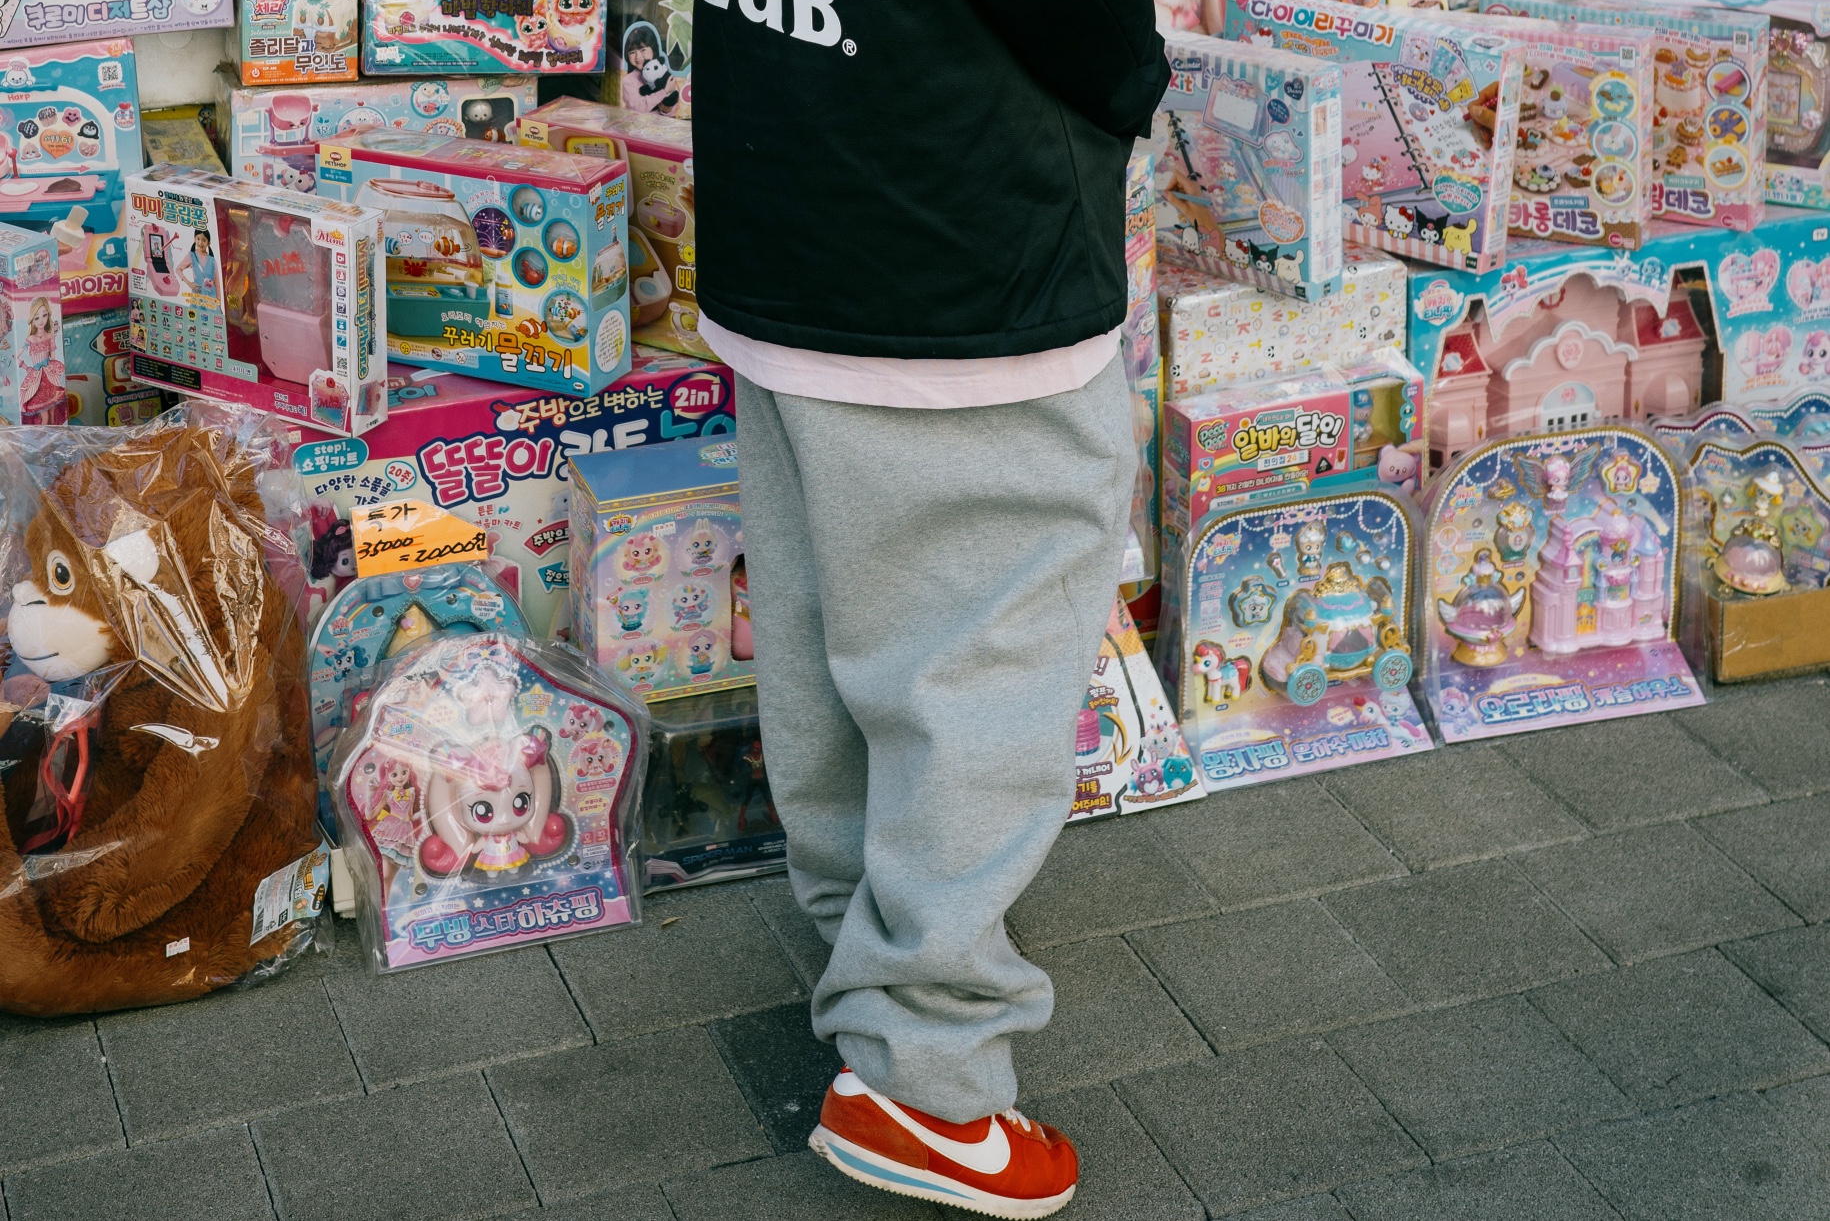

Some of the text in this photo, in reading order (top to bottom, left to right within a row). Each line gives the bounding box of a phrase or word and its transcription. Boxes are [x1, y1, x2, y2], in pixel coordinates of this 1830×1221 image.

[26, 0, 85, 32] 쿠로미
[1249, 0, 1395, 46] 다이어리꾸미기
[294, 53, 348, 75] 무인도
[1169, 72, 1193, 94] Kit
[7, 92, 31, 103] Harp
[325, 160, 348, 168] PETSHOP
[132, 193, 163, 220] 미미
[162, 199, 209, 230] 플립폰
[1664, 188, 1713, 215] 데코
[1552, 210, 1601, 236] 데코
[1814, 229, 1826, 240] TV
[315, 229, 346, 247] Mimi
[260, 258, 308, 278] Mimi
[442, 325, 573, 379] 꾸러기 물꼬기
[673, 385, 721, 408] 2in1
[514, 385, 665, 434] 주방으로 변하는
[1233, 412, 1346, 462] 알바의 달인
[314, 443, 352, 457] step1.
[301, 455, 359, 472] 쇼핑카트
[424, 437, 552, 505] 똘똘이
[314, 475, 392, 497] 다양한 소품을
[368, 502, 417, 533] 특가
[477, 503, 495, 516] 튼튼
[503, 519, 522, 531] 카트
[357, 536, 414, 561] 35000
[1202, 740, 1289, 779] 왕자핑
[1292, 737, 1349, 763] 은하수
[413, 915, 472, 949] 무빙
